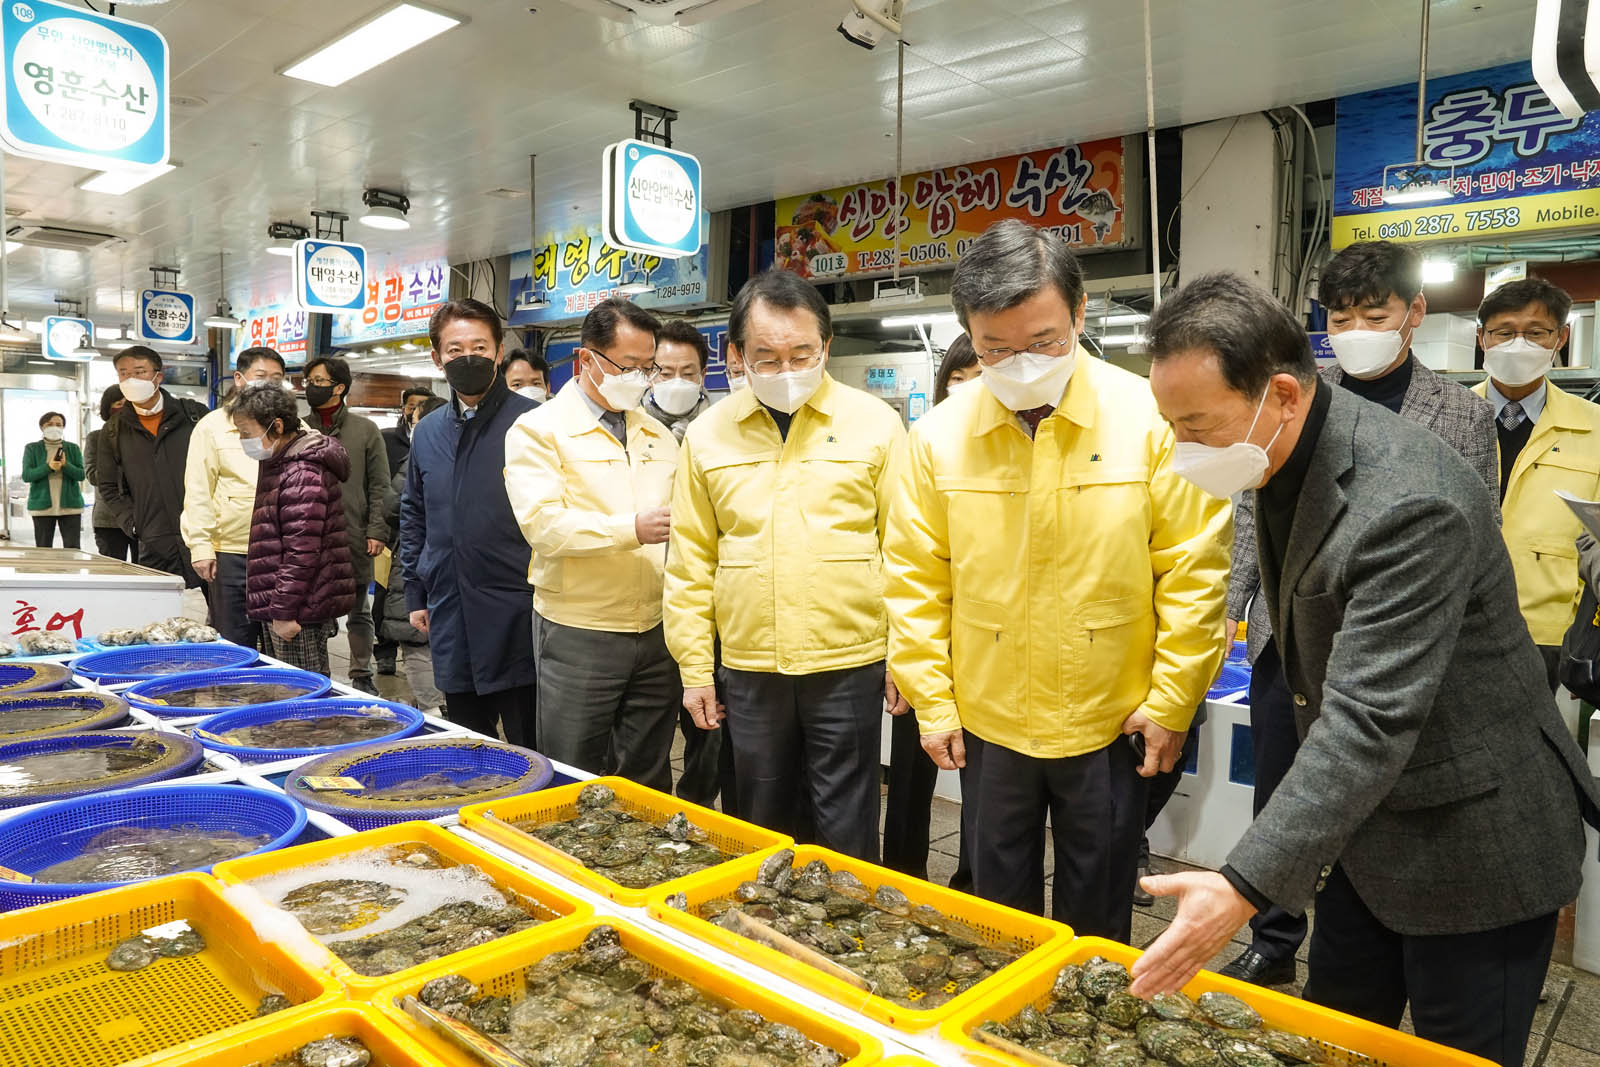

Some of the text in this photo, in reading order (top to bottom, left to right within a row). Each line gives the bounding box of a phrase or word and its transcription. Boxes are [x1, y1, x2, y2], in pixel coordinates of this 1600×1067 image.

[13, 5, 34, 20] 108
[23, 61, 150, 115] 영훈수산
[1005, 144, 1092, 217] 수산
[1352, 226, 1375, 240] Tel.
[1379, 220, 1412, 239] 061)
[1466, 206, 1520, 231] 7558
[814, 253, 847, 273] 101호
[311, 266, 360, 286] 대영수산
[147, 308, 188, 322] 영광수산
